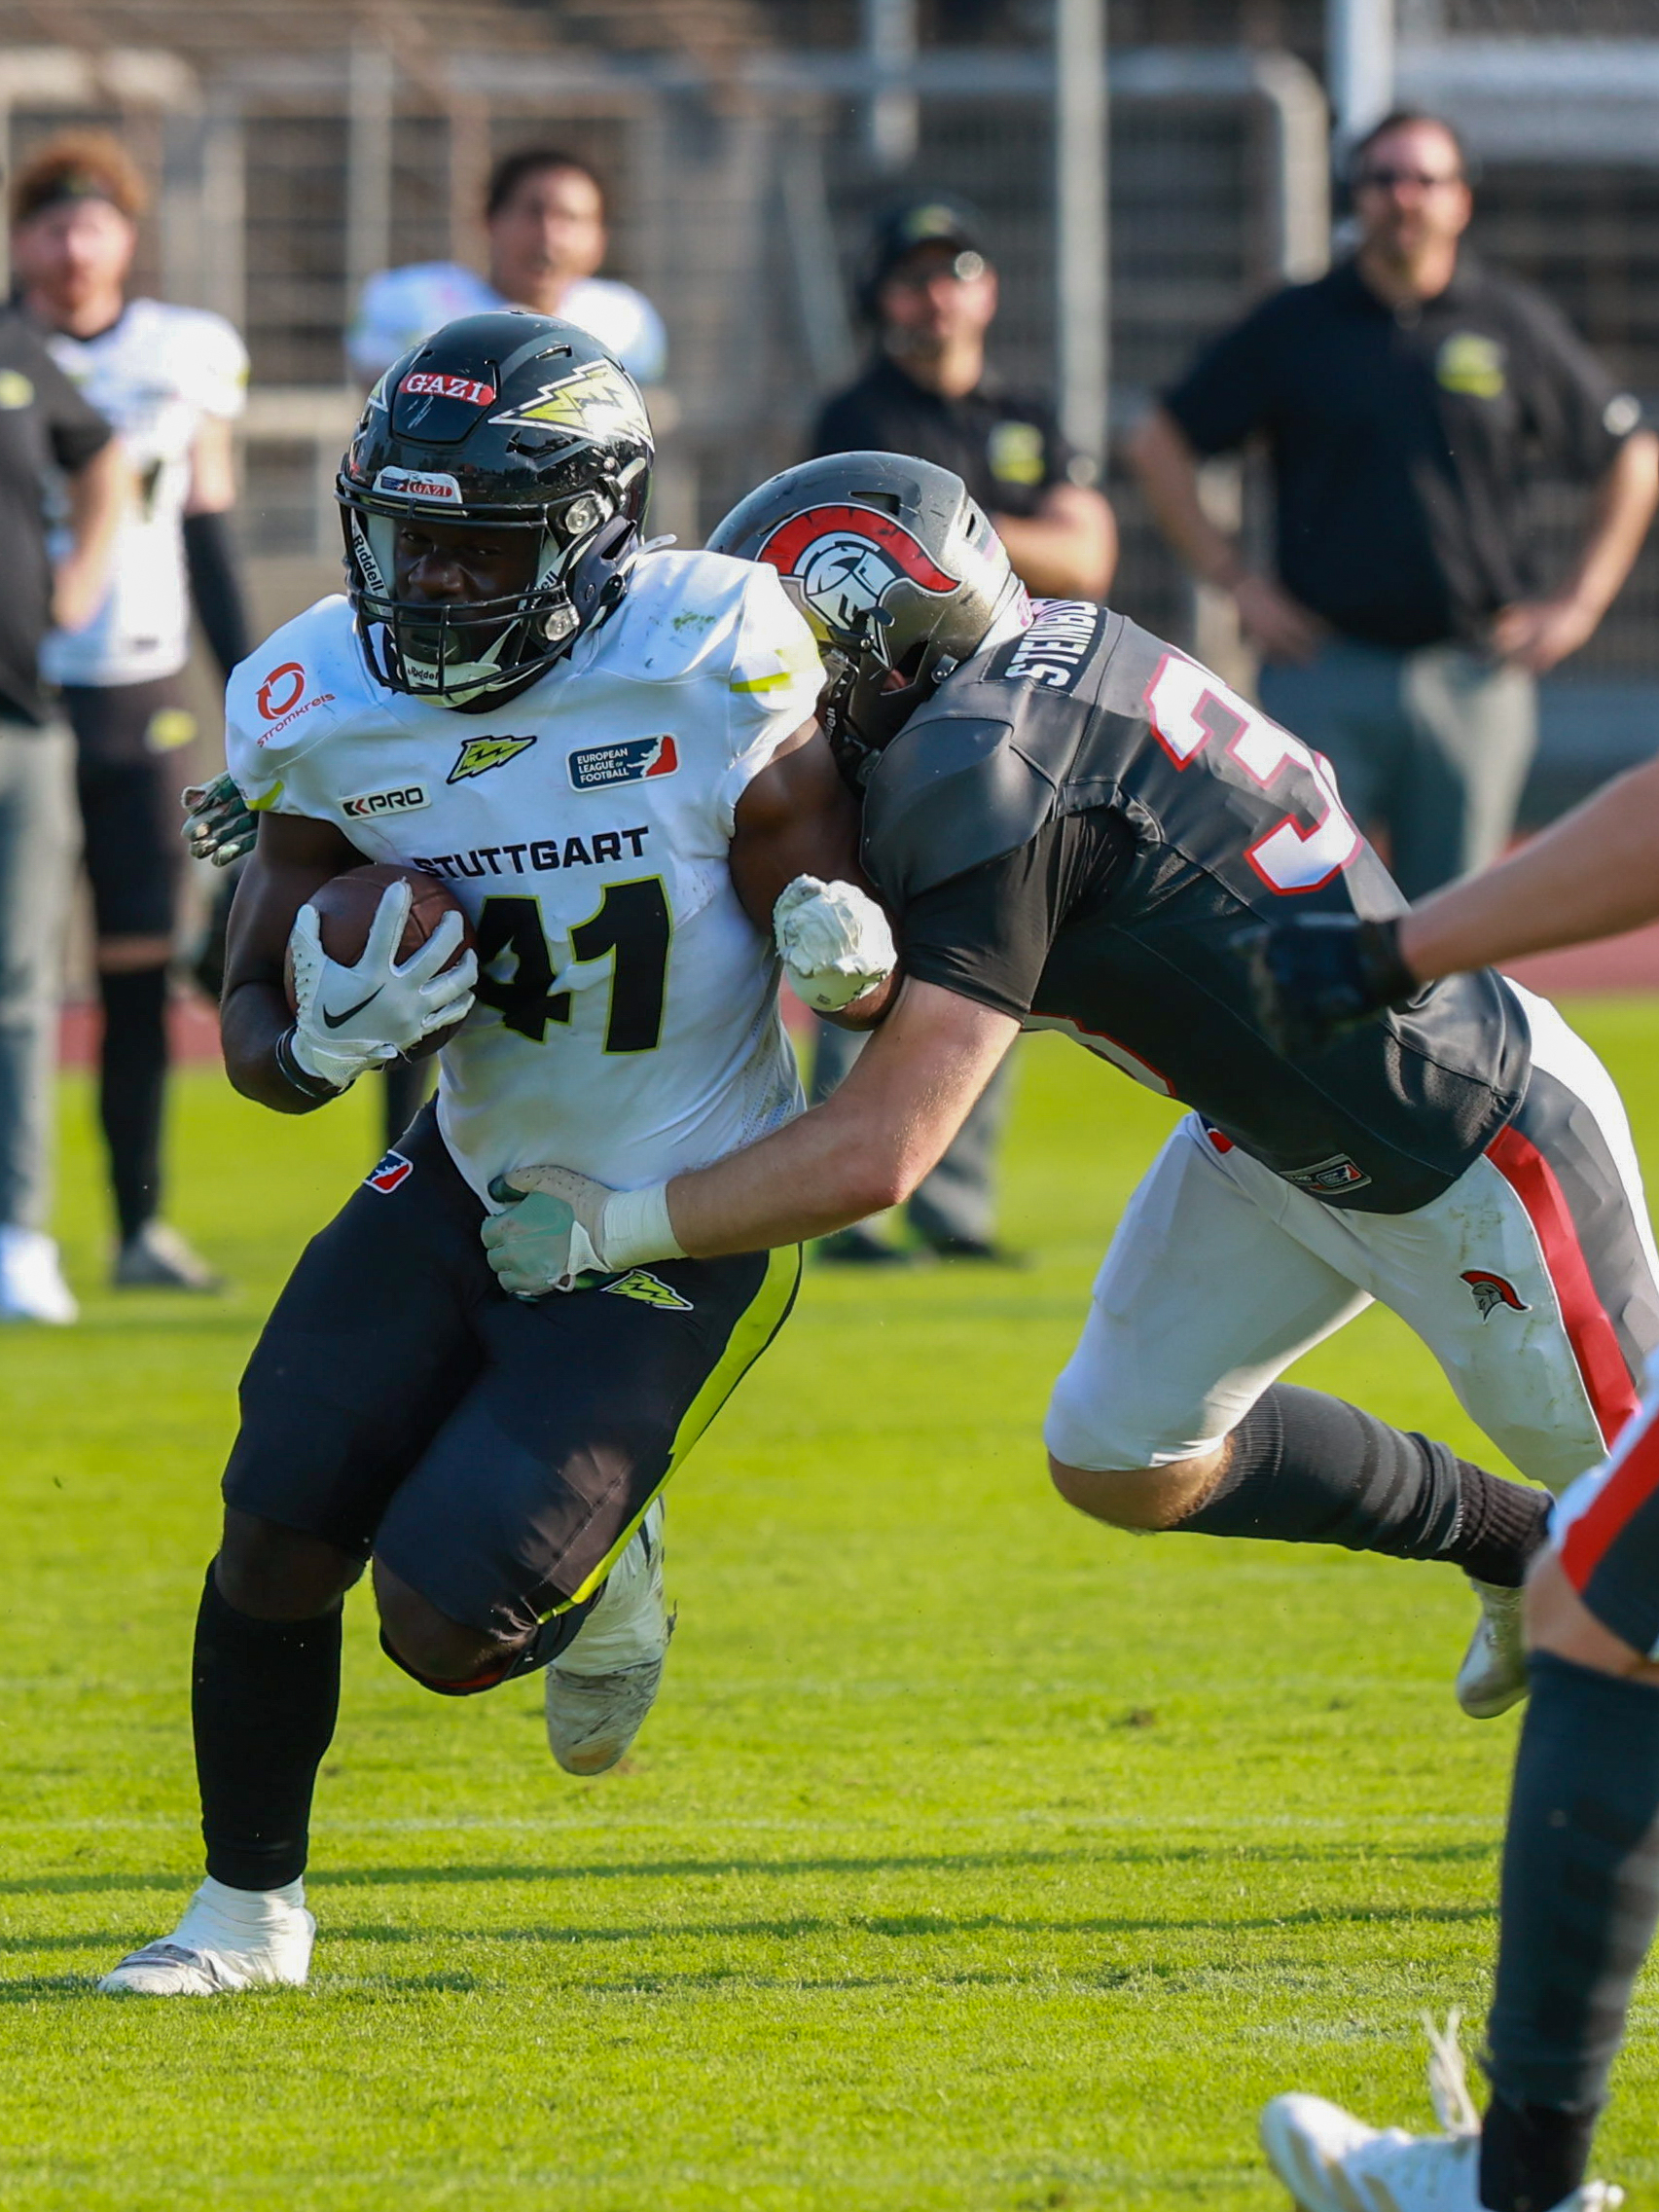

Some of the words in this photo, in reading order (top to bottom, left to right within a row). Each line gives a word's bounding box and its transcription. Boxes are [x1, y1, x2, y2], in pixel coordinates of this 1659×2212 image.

[406, 373, 484, 403] GAZI
[413, 484, 448, 496] GAZI
[353, 534, 384, 592] Riddell
[411, 666, 441, 681] Riddel
[256, 693, 337, 748] stromkreis
[576, 747, 630, 765] EUROPEAN
[578, 760, 615, 775] LEAGUE
[1142, 643, 1363, 896] 3
[579, 767, 631, 784] FOOTBALL
[412, 825, 650, 880] STUTTGART
[471, 873, 672, 1056] 41
